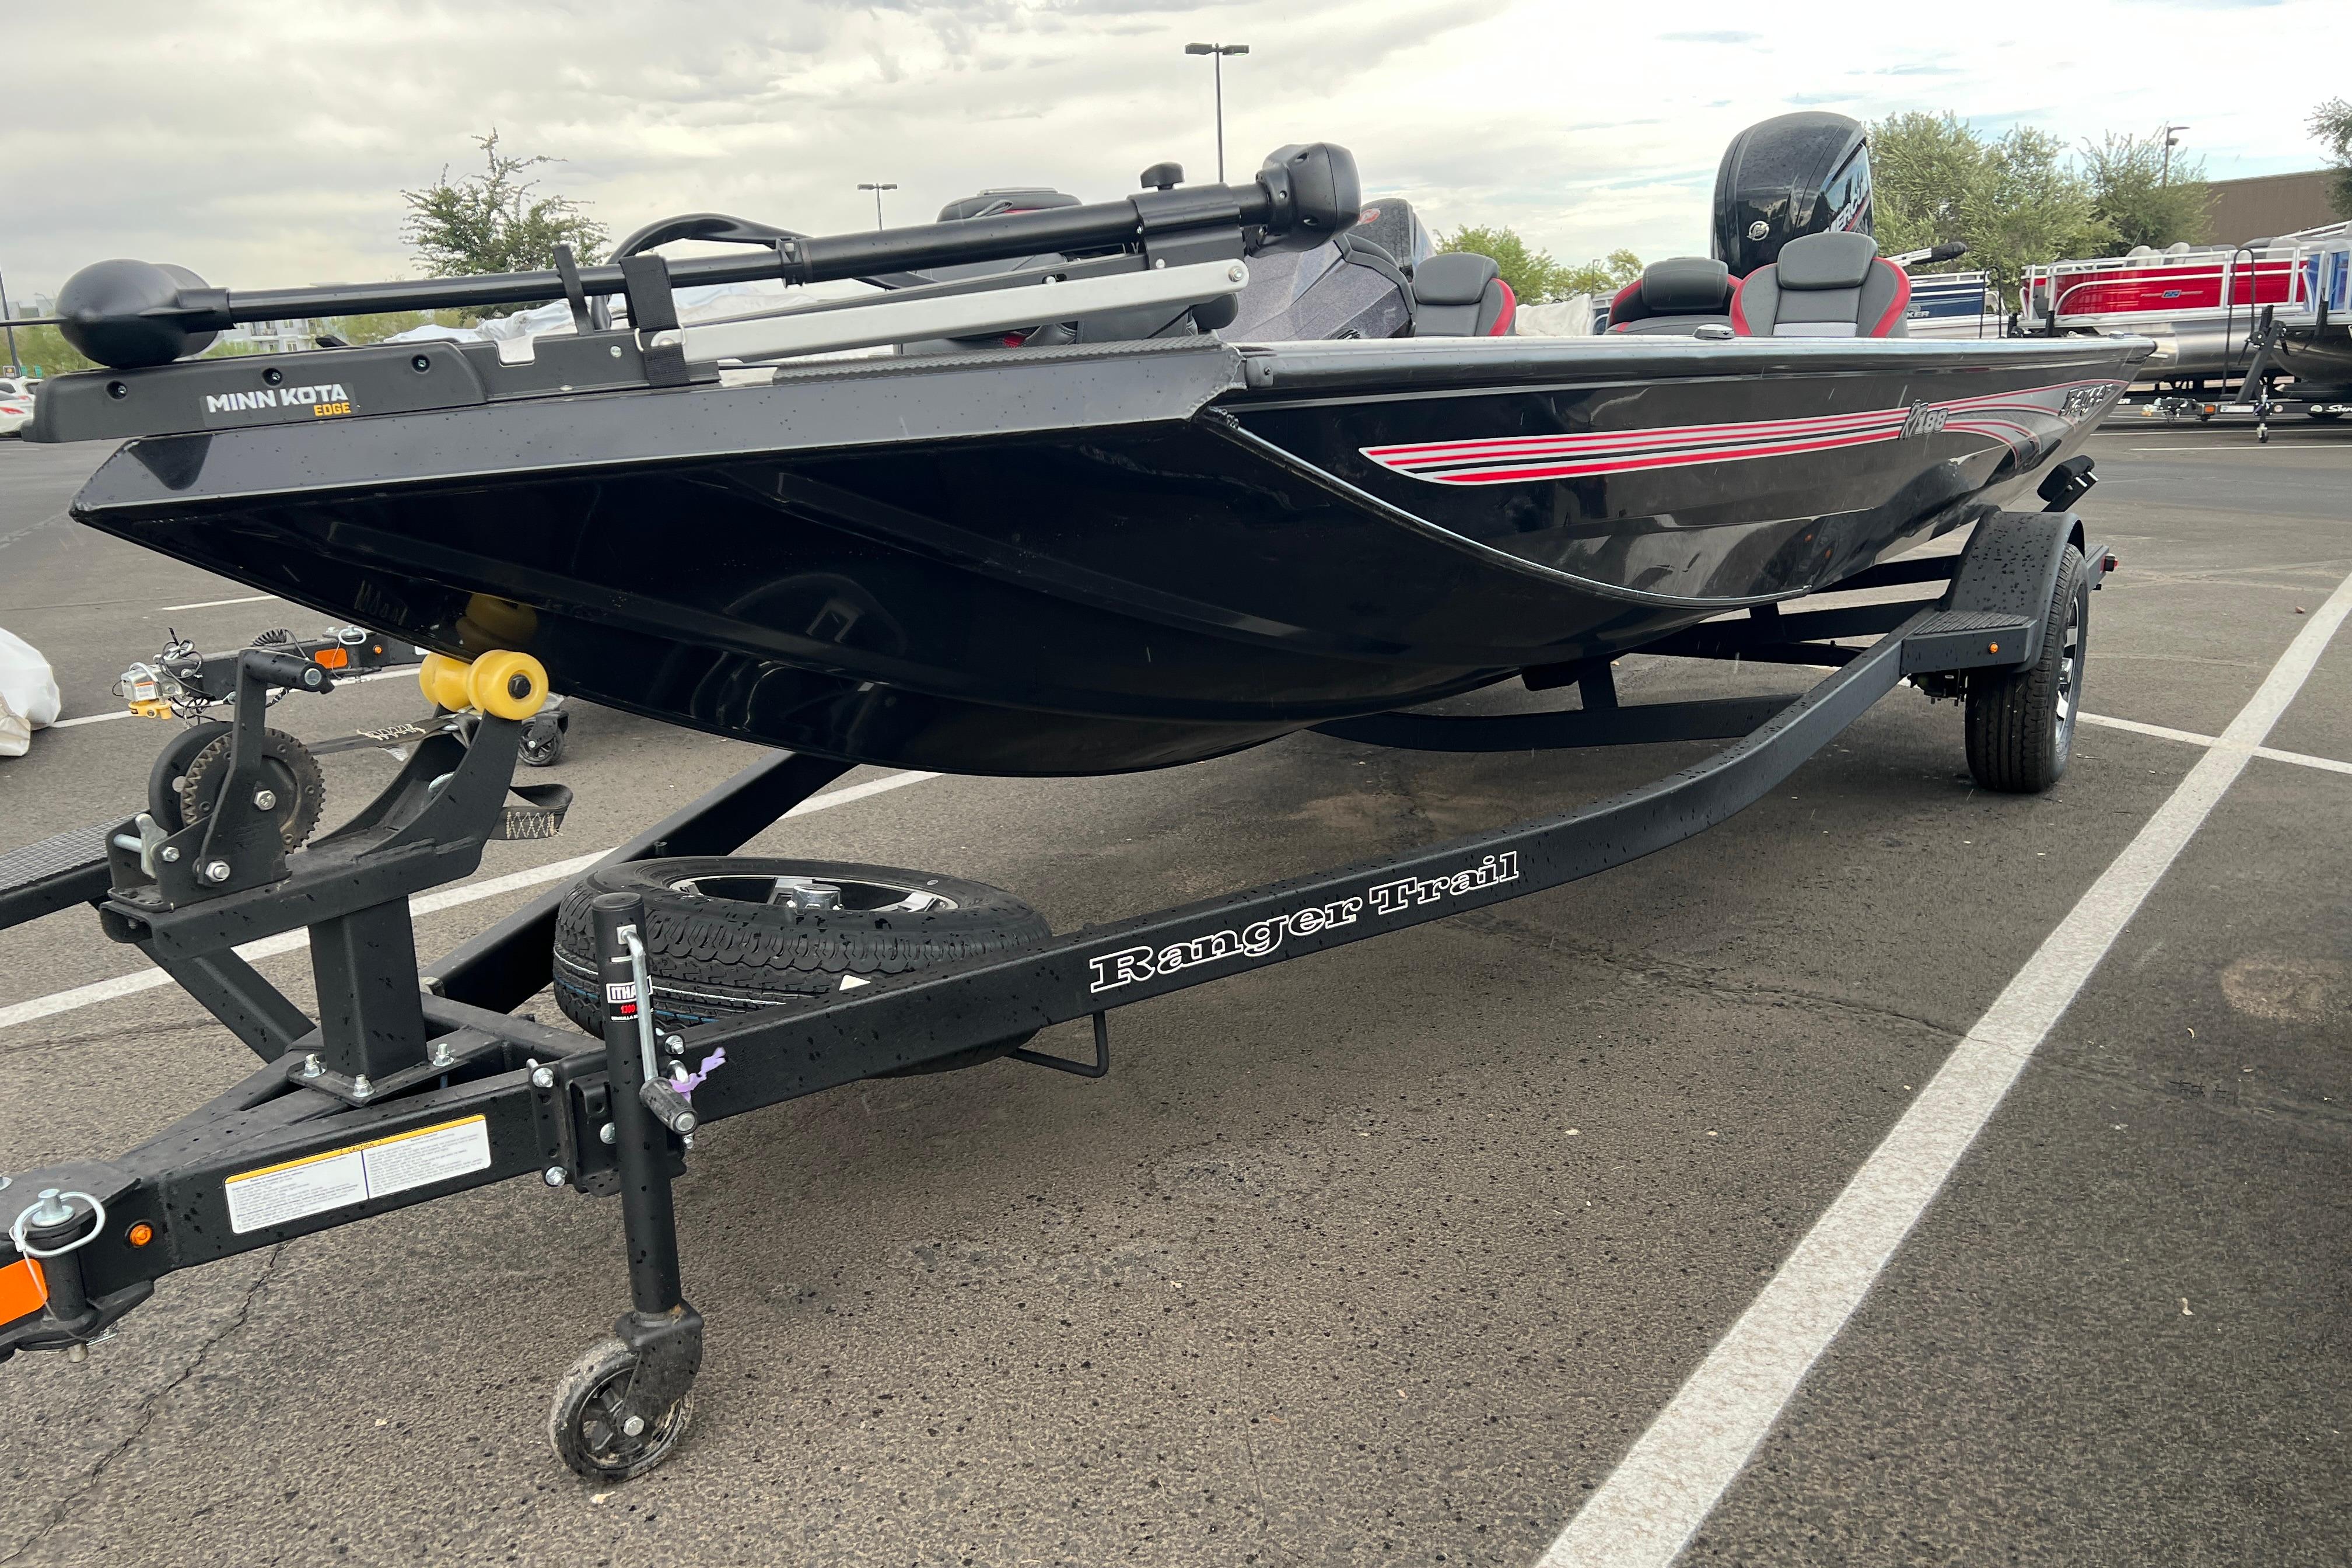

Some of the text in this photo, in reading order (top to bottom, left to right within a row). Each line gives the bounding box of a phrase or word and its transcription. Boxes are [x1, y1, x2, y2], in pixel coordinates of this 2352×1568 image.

[206, 384, 349, 413] MINN KOTA
[313, 402, 351, 416] EDGE
[1090, 851, 1518, 993] Ranger Trail
[348, 1142, 374, 1152] CAUTION
